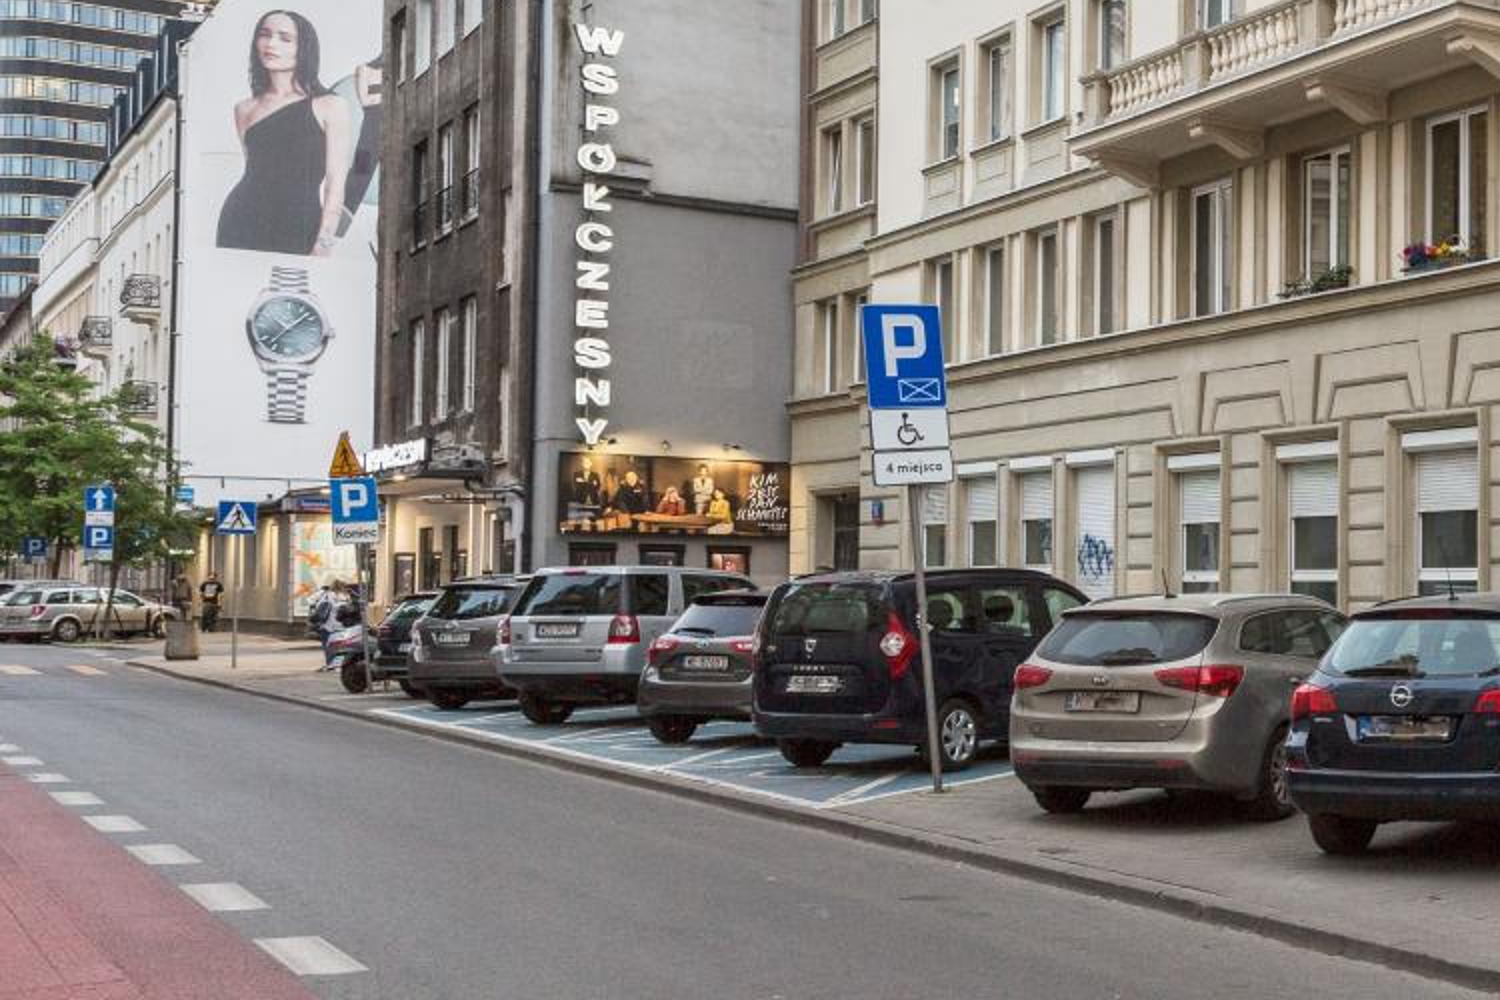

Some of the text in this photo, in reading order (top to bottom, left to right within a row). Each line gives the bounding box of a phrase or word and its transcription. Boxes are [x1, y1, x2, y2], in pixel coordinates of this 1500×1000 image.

[880, 313, 927, 377] P
[886, 462, 943, 475] 4 miejsca
[341, 483, 368, 517] P
[28, 538, 42, 553] P
[91, 528, 108, 546] P
